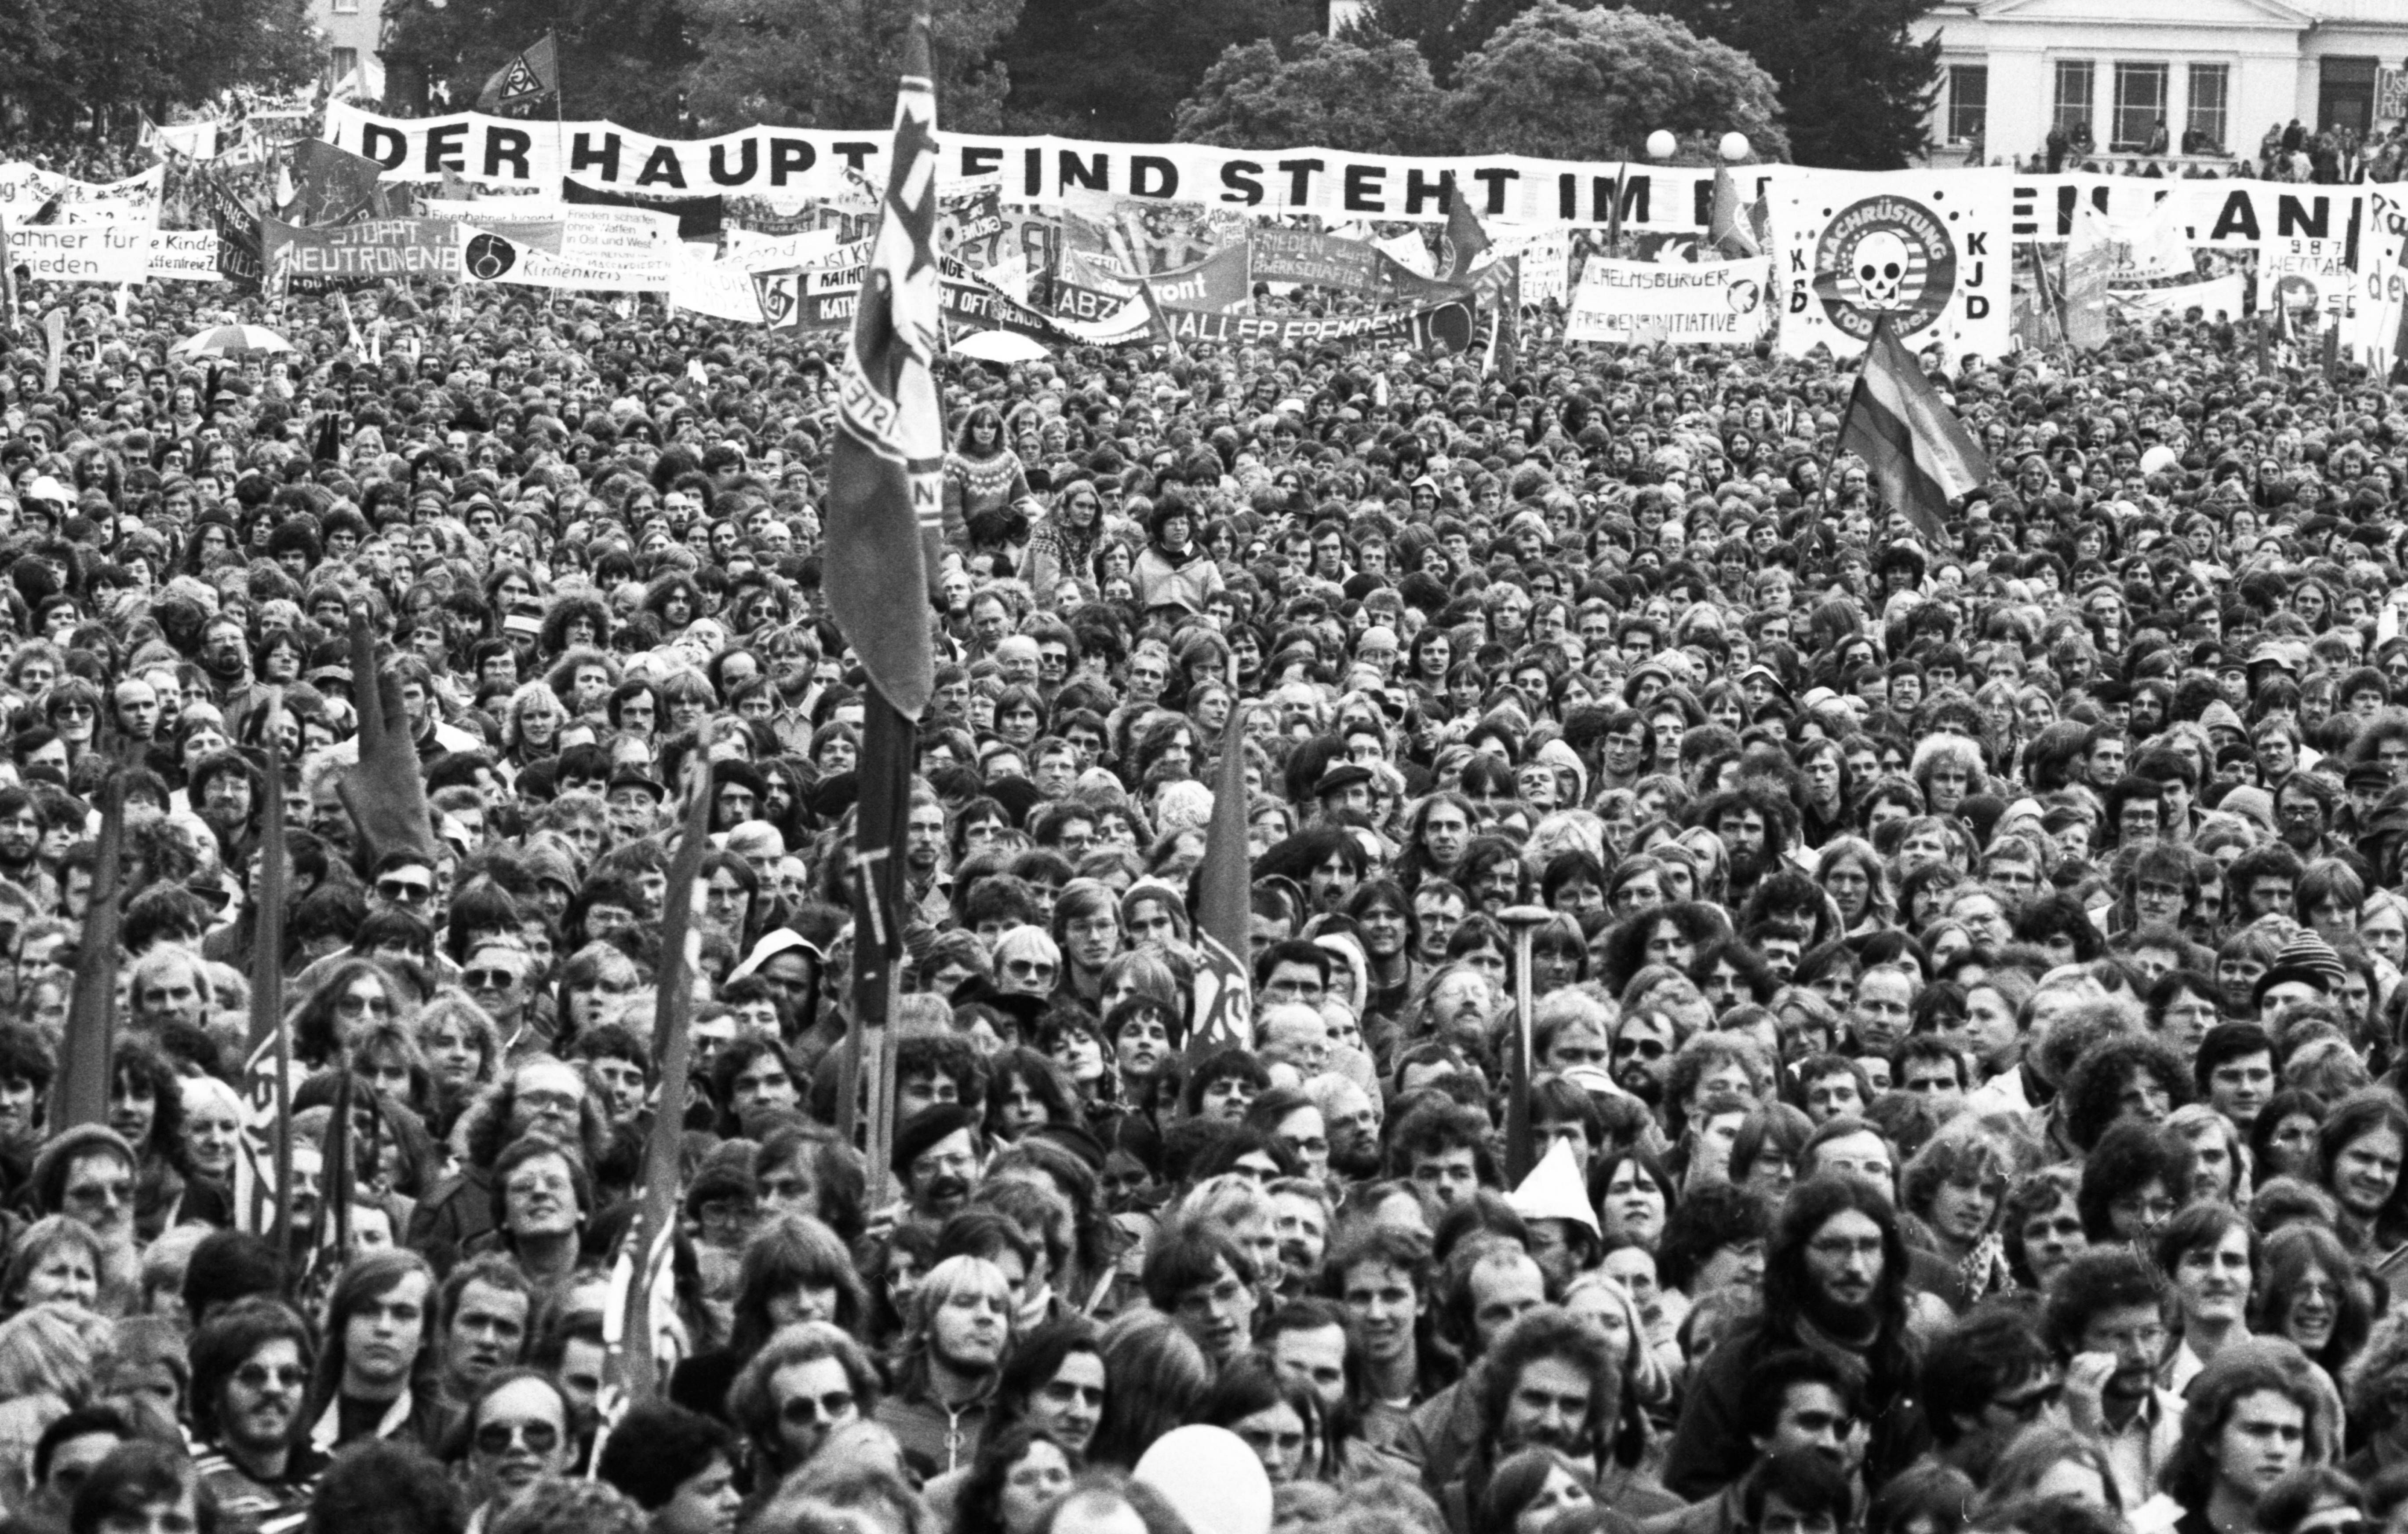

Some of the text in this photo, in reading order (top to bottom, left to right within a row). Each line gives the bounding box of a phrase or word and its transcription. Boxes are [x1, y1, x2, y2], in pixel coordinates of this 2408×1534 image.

[362, 120, 532, 179] DER
[1220, 157, 1519, 215] STEHT
[1559, 173, 1650, 223] IM
[567, 209, 609, 221] Frieden
[567, 222, 595, 232] ohne
[330, 221, 420, 245] STOPPT
[579, 234, 598, 245] Ost
[601, 235, 623, 246] und
[626, 236, 652, 249] West
[1820, 199, 1947, 271] NACHRÜSTUNG
[10, 249, 98, 274] Frieden
[1583, 265, 1730, 289] WILHELMSBURGER
[961, 292, 990, 316] OFT
[1576, 310, 1738, 332] FRIEDENSINITIATIVE
[1835, 303, 1873, 336] TOD
